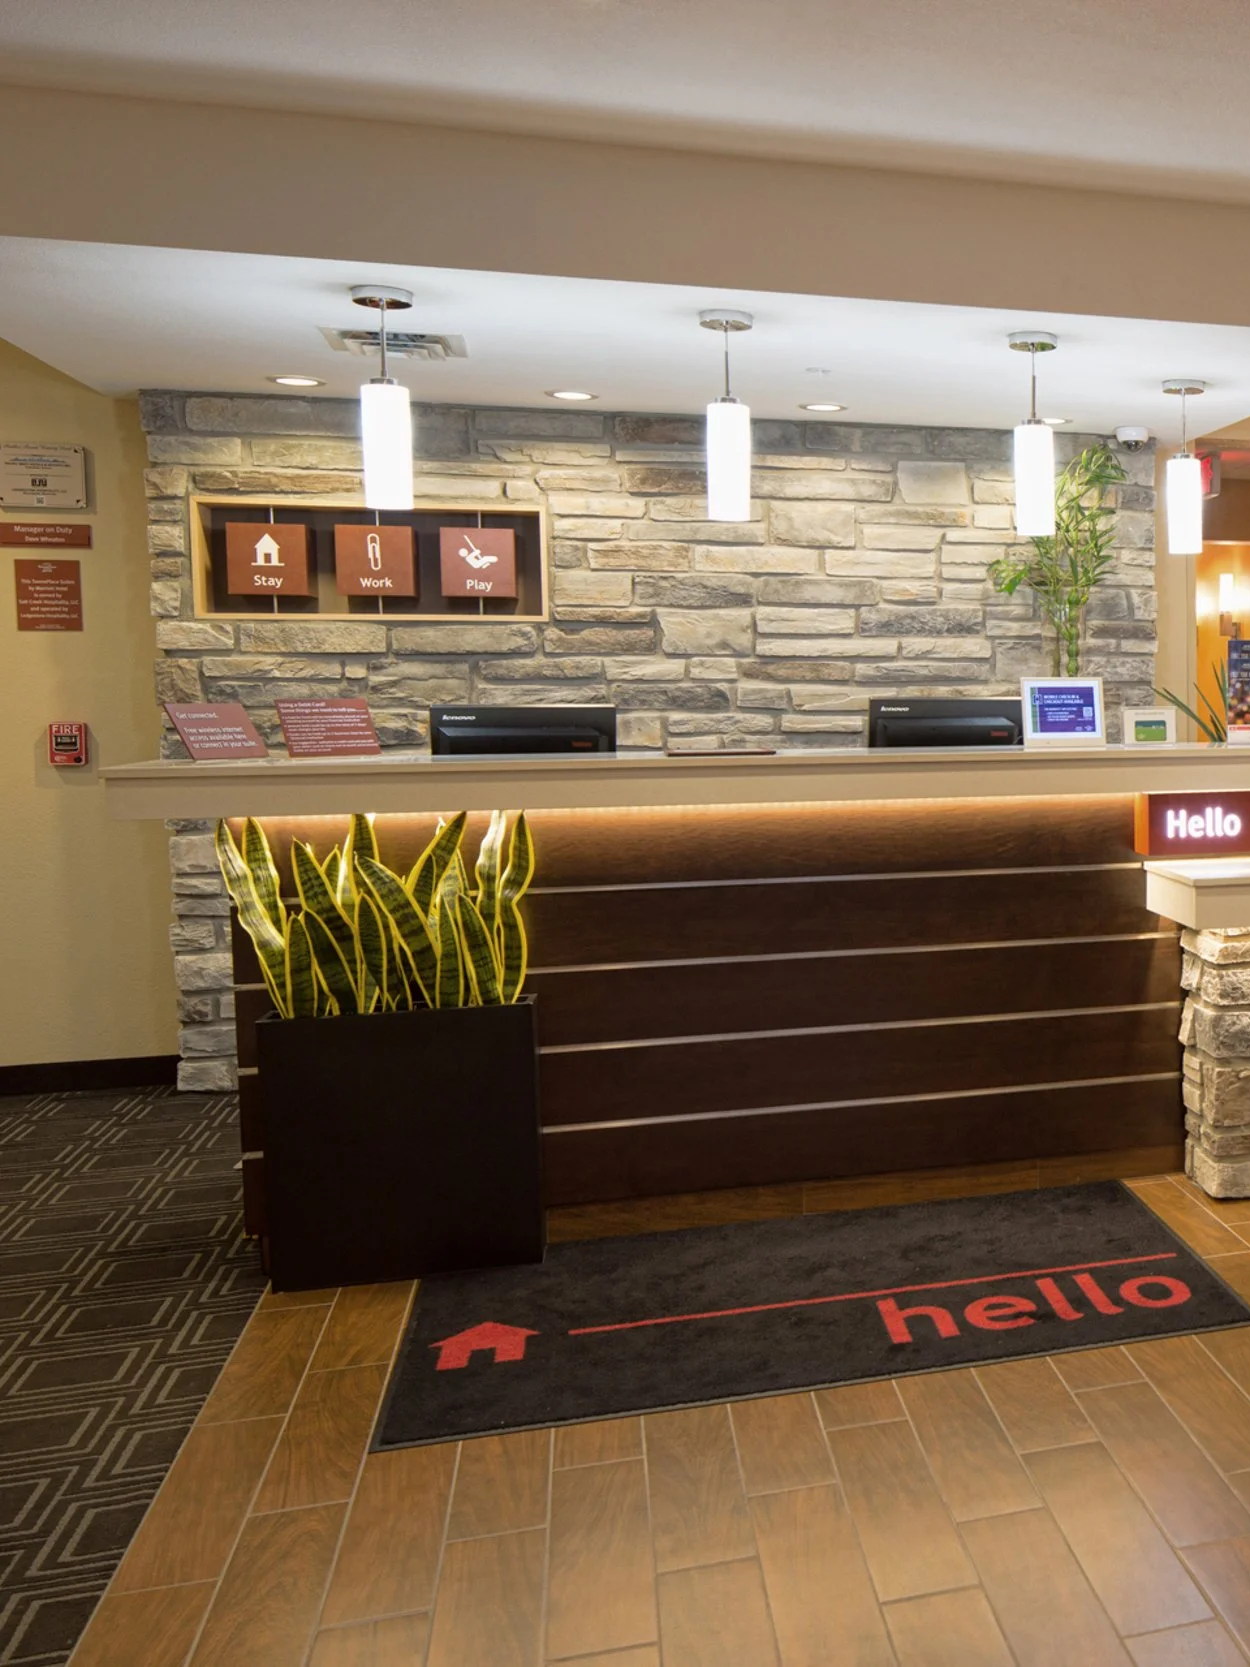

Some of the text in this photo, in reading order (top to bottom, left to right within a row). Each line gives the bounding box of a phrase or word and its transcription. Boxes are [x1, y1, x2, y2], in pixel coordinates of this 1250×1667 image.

[14, 526, 44, 534] Manager
[56, 526, 73, 534] Duty
[254, 575, 283, 588] Stay
[360, 576, 393, 588] Work
[466, 578, 492, 592] Play
[52, 725, 80, 734] FIRE
[1166, 806, 1242, 839] Hello
[876, 1273, 1193, 1344] hello
